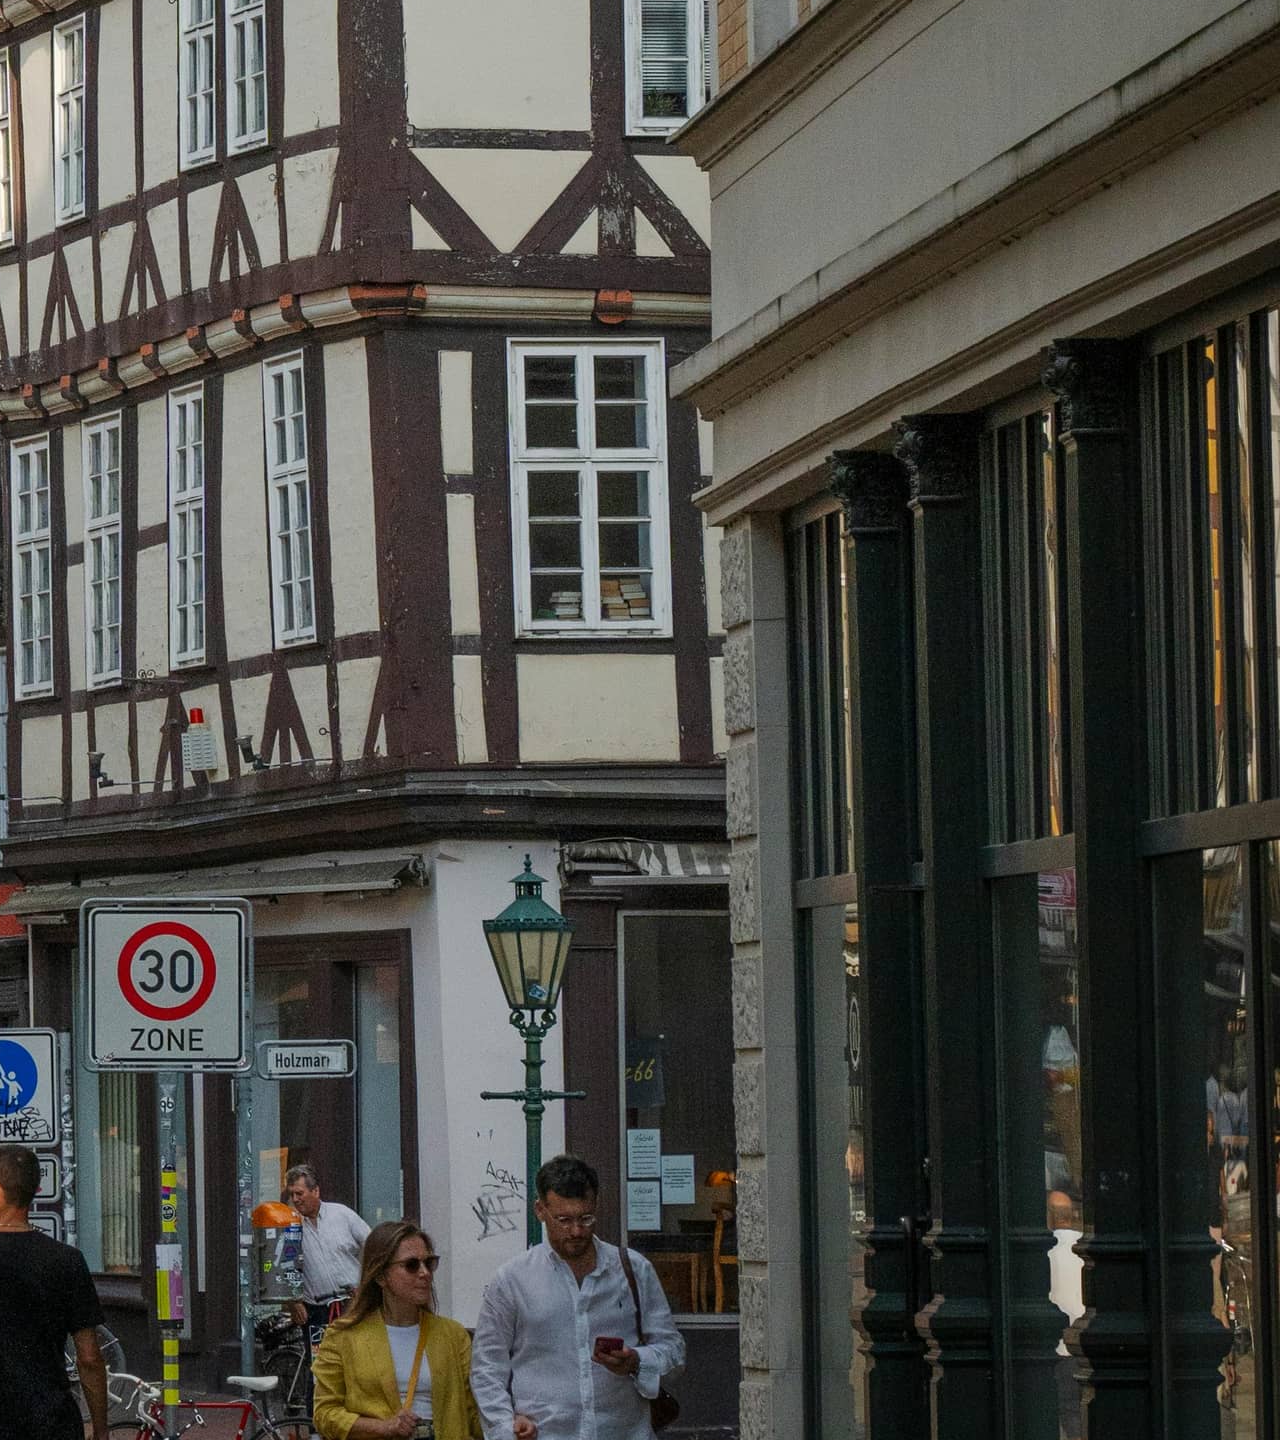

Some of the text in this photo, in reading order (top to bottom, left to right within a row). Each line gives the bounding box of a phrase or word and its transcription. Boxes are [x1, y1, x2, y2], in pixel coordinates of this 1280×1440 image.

[138, 949, 195, 994] 30
[130, 1028, 204, 1052] ZONE
[275, 1053, 330, 1068] Holzmar
